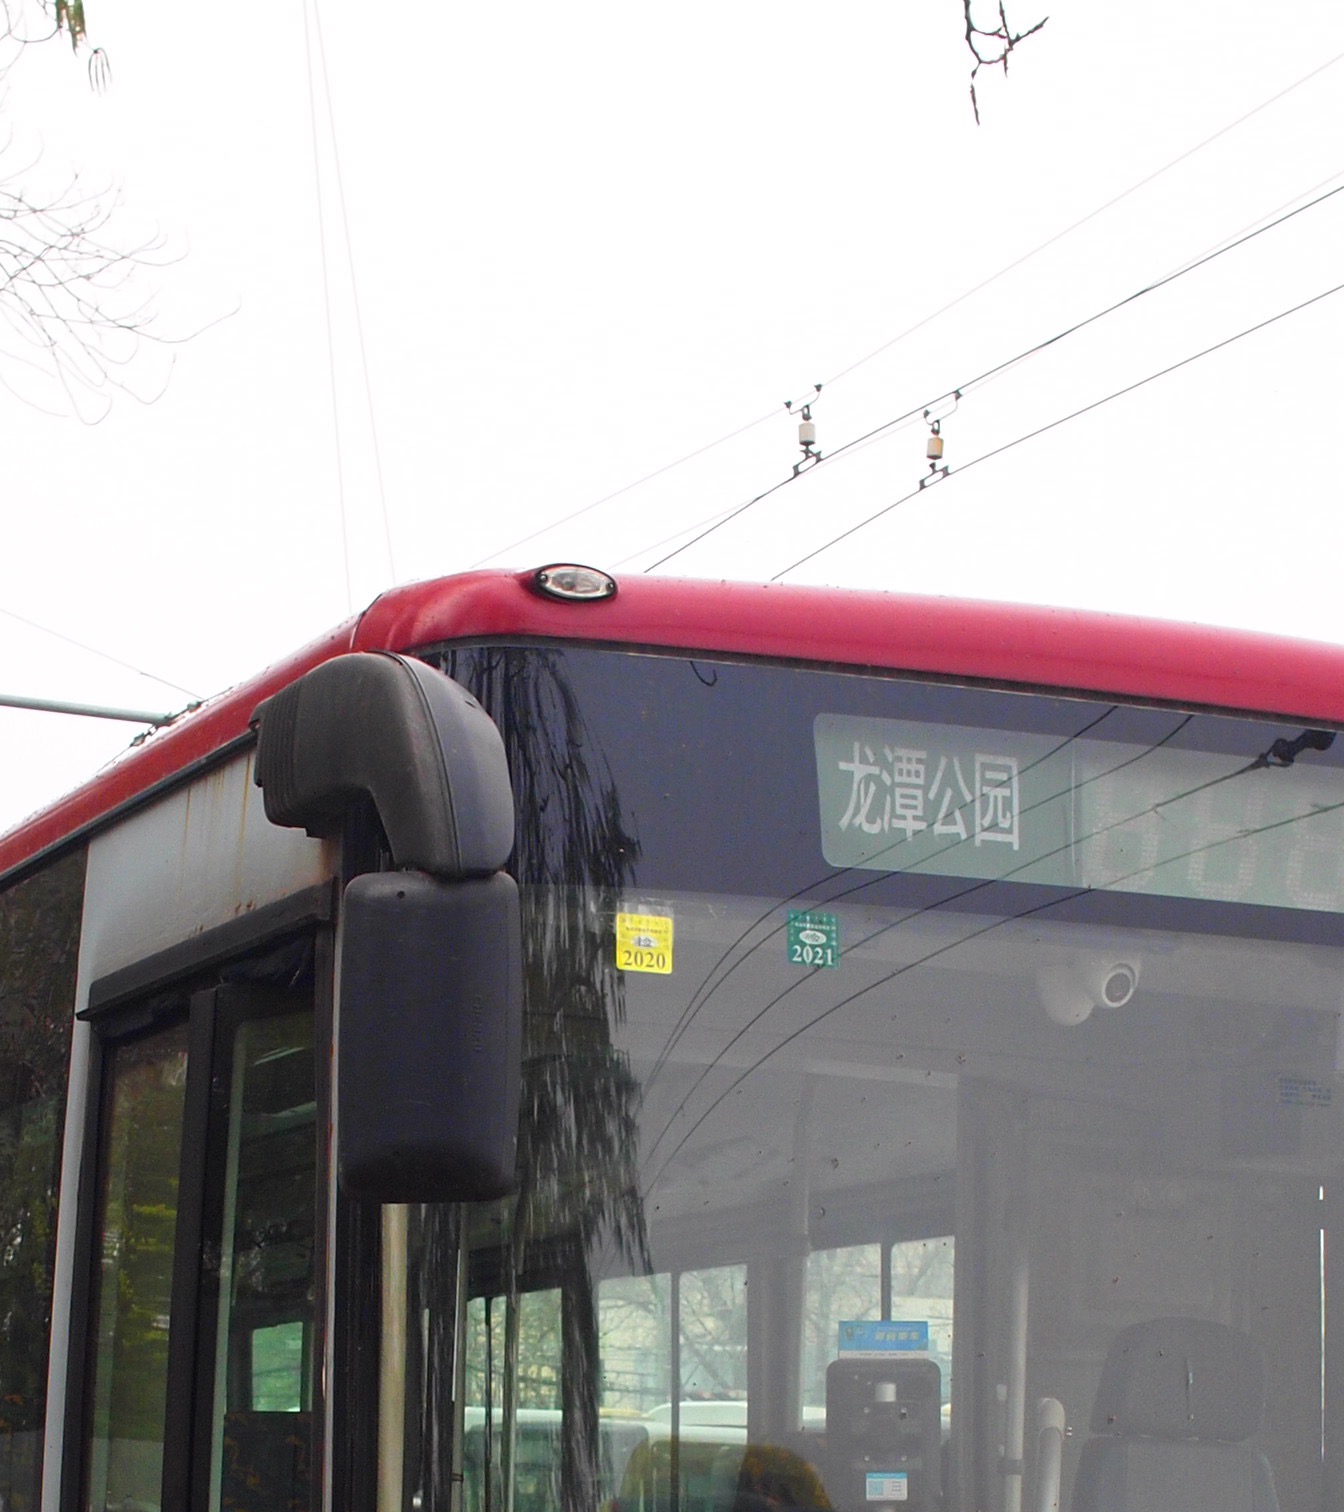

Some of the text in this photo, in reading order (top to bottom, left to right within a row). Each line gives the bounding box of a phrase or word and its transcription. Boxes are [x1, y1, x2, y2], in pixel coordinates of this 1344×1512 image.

[837, 741, 1020, 851] 龙潭公园
[623, 950, 666, 970] 2020
[791, 944, 834, 966] 2021
